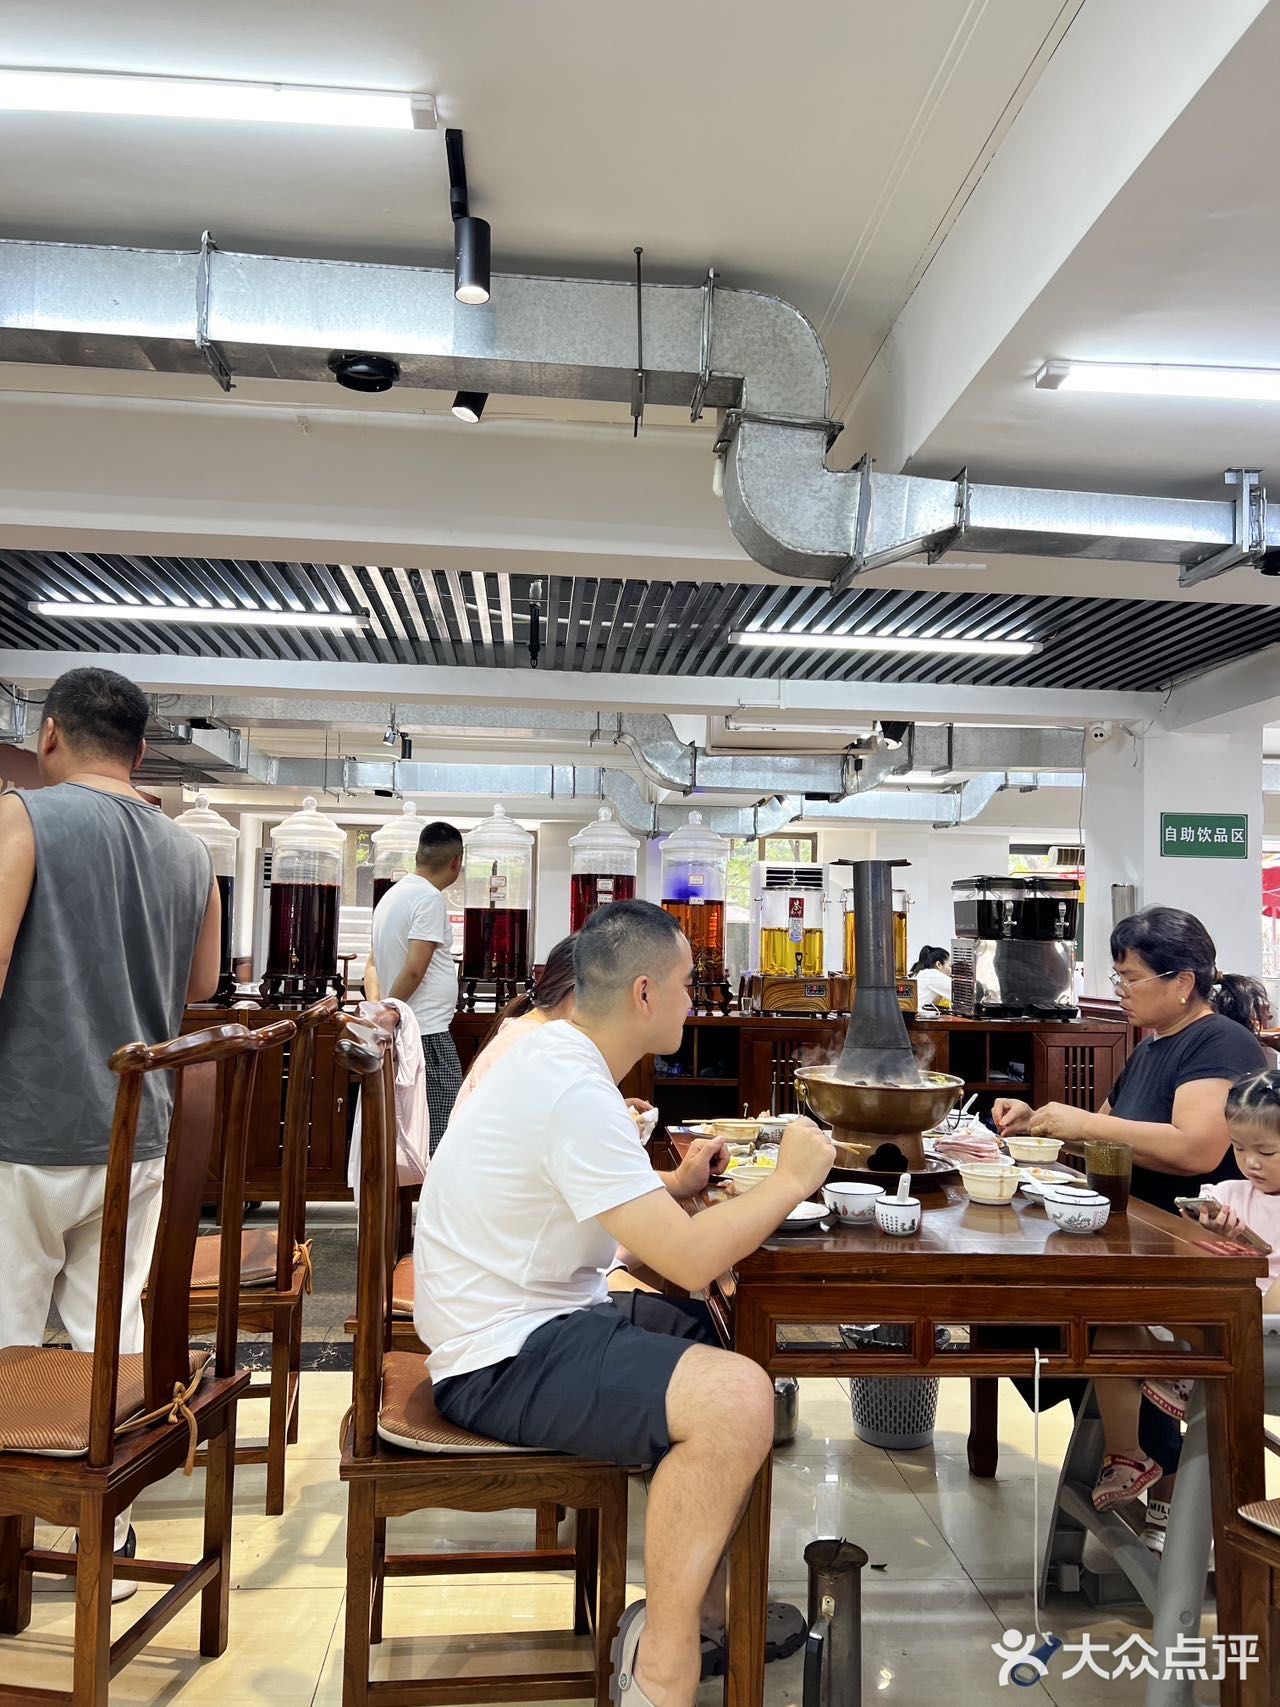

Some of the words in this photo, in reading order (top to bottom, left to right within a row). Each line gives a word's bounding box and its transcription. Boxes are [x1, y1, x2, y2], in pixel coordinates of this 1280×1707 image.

[1165, 826, 1245, 843] 自助饮品区
